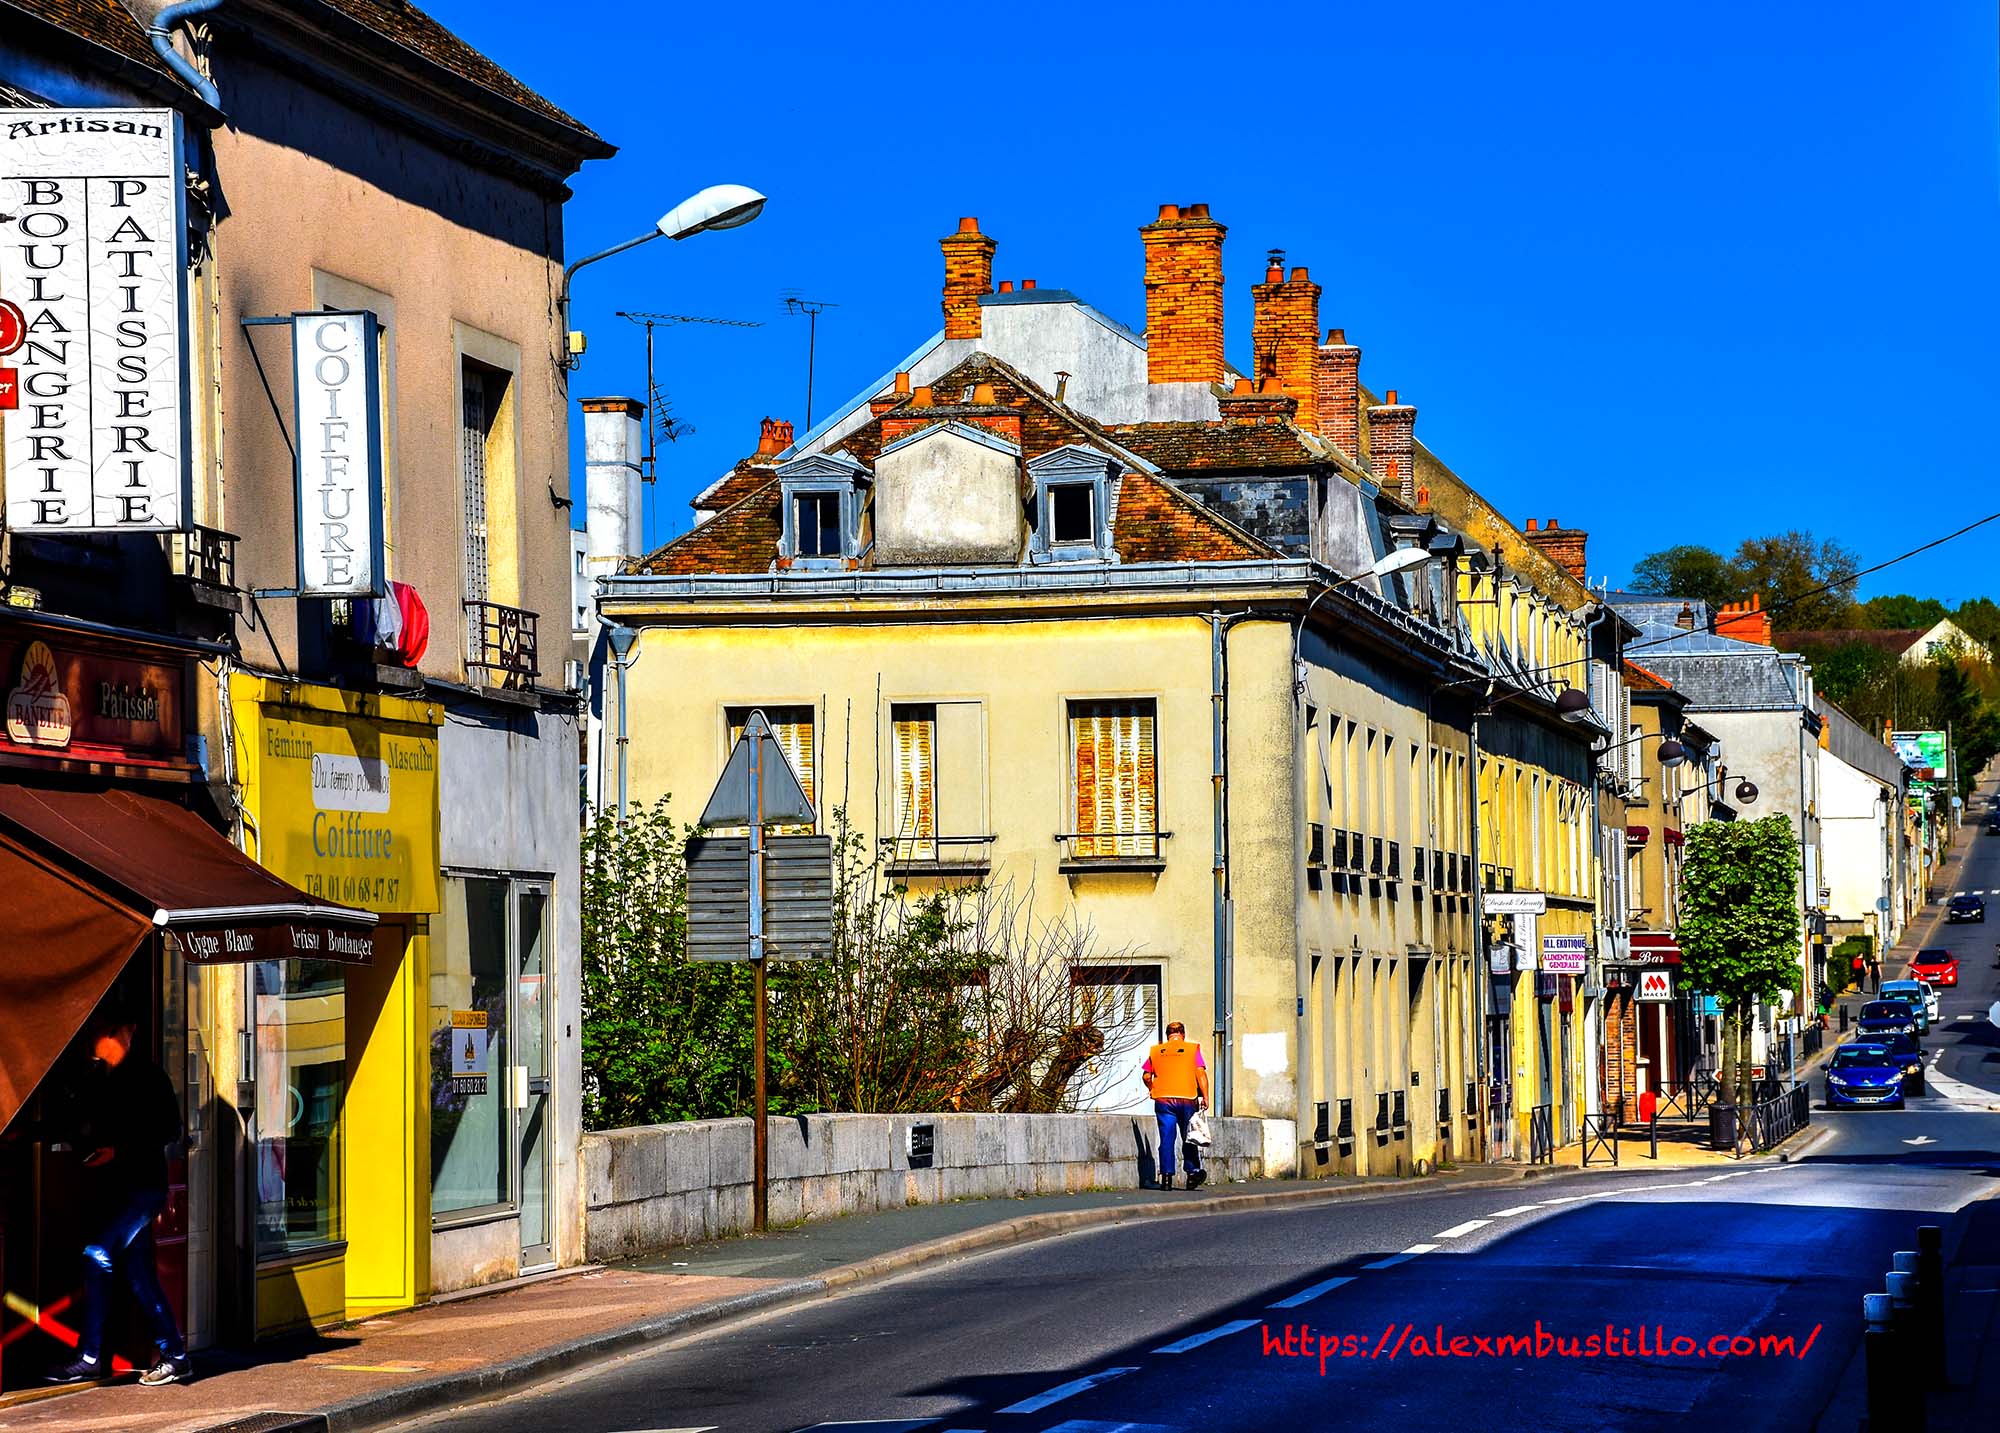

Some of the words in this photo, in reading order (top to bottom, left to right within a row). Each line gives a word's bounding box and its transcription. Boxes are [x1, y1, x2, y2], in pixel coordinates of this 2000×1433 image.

[7, 116, 163, 140] Artisan
[18, 179, 72, 526] BOULANGERIE
[104, 179, 157, 525] PATISSERIE
[315, 320, 354, 587] COIFFURE
[15, 703, 65, 730] BANETTE
[100, 681, 161, 721] Pâtissier
[266, 727, 313, 760] Féminin
[387, 741, 433, 772] Masculin
[311, 753, 327, 790] Du
[330, 762, 354, 801] temps
[312, 811, 393, 860] Coiffure
[328, 874, 340, 901] 01
[343, 875, 356, 903] 60
[358, 876, 371, 904] 68
[373, 877, 385, 904] 47
[387, 878, 400, 904] 87
[186, 931, 219, 960] Cygne
[224, 928, 254, 952] Blanc
[327, 928, 374, 959] Boulanger
[1544, 953, 1585, 961] ALIMENTATION
[1556, 939, 1585, 949] EXOTIQUE
[1638, 951, 1665, 964] Bar
[1549, 961, 1580, 969] GENERALE
